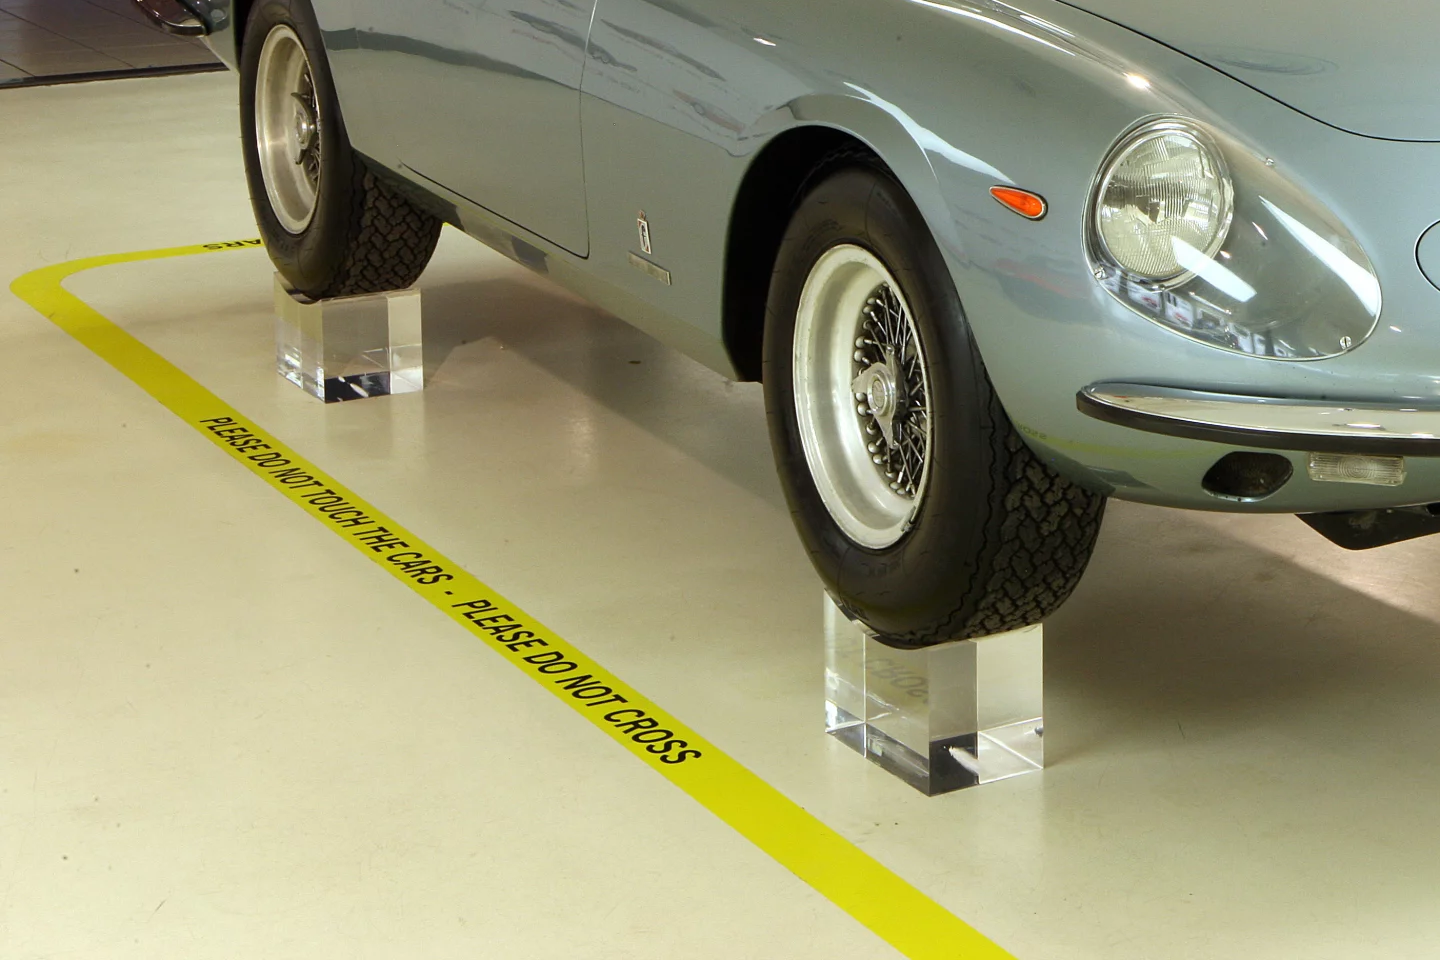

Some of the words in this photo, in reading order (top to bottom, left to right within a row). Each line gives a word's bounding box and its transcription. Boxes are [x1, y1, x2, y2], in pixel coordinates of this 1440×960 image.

[203, 239, 263, 251] ARS
[200, 417, 269, 454] PLEASE
[248, 451, 285, 468] DO
[269, 467, 323, 490] NOT
[301, 489, 374, 528] TOUCH
[353, 526, 410, 553] THE
[386, 552, 454, 585] CARS
[452, 599, 548, 652] PLEASE
[523, 651, 578, 674] DO
[555, 674, 627, 708] NOT
[603, 708, 702, 765] CROSS
